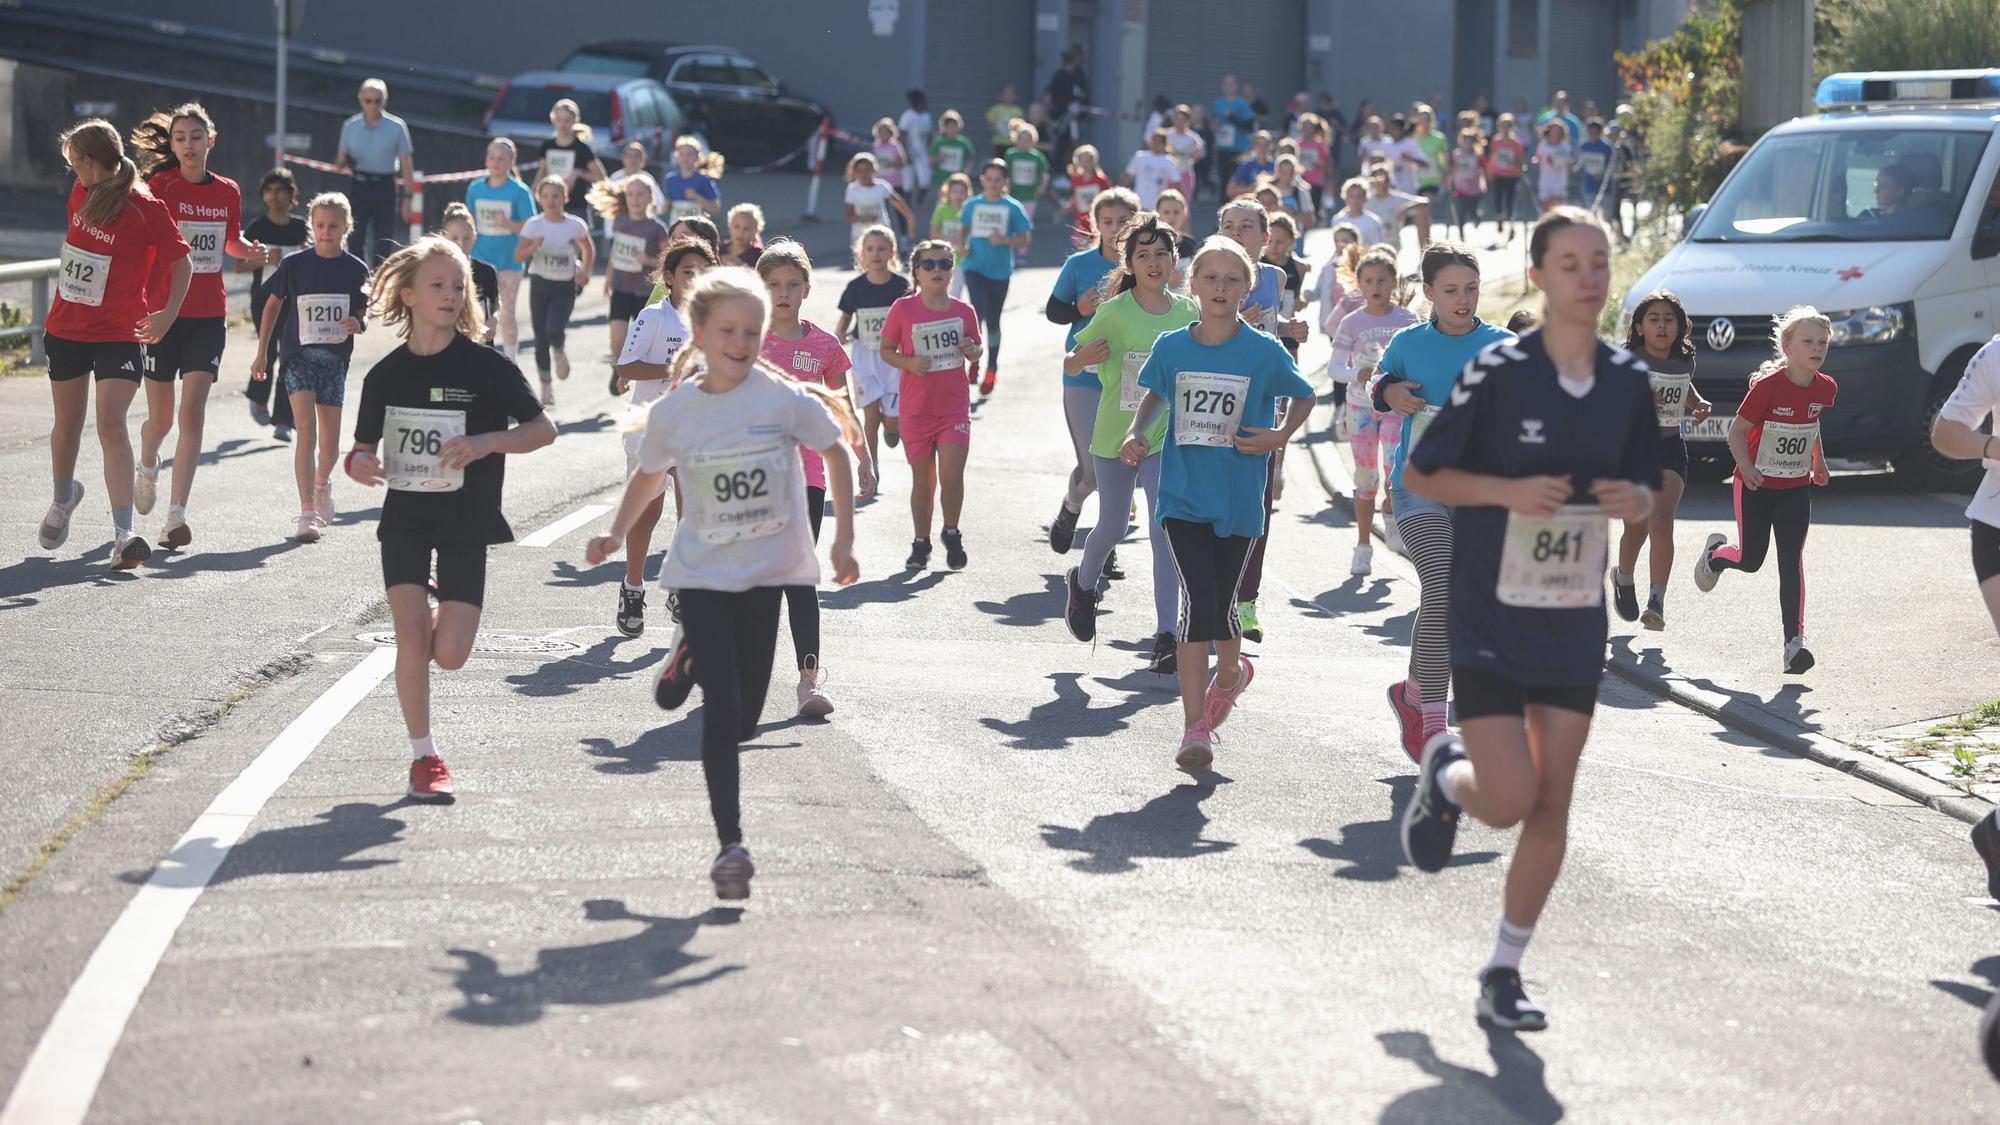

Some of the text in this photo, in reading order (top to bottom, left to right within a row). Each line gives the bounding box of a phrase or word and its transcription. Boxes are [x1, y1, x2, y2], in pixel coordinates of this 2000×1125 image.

[179, 202, 228, 219] RS Hepel
[190, 234, 216, 251] 403
[65, 260, 94, 283] 412
[305, 305, 342, 322] 1210
[922, 330, 959, 350] 1199
[1183, 389, 1236, 416] 1276
[1190, 421, 1222, 431] Pauline
[1707, 420, 1725, 435] RK
[398, 427, 441, 456] 796
[1775, 437, 1807, 455] 360
[404, 464, 429, 473] Lotte
[713, 468, 769, 503] 962
[1533, 530, 1584, 563] 841
